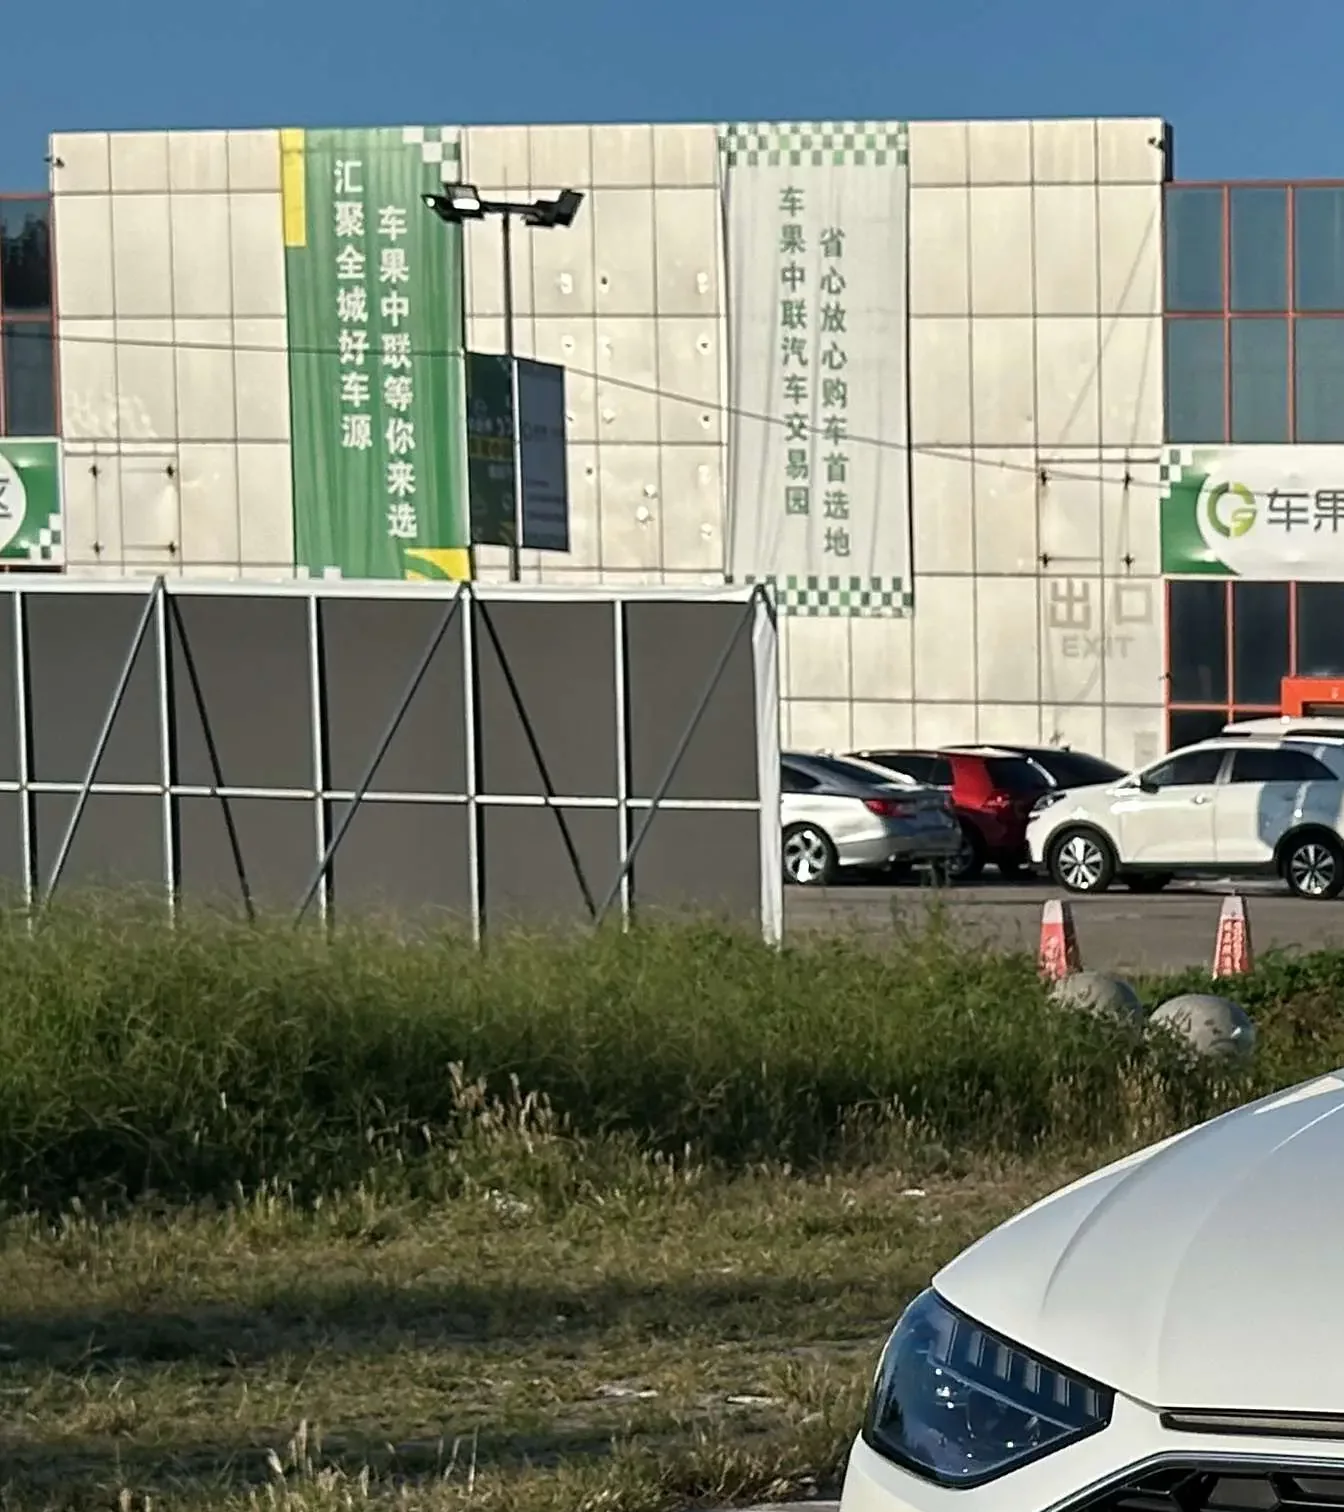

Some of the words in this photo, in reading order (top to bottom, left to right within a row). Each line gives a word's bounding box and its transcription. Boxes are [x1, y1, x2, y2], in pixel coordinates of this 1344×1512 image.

[334, 159, 373, 451] 汇聚全城好车源
[378, 205, 418, 539] 车果中联等你来选
[780, 186, 810, 516] 车果中联汽车交易园
[819, 228, 851, 557] 省心放心购车首选地
[1048, 578, 1153, 630] 出口
[1061, 634, 1136, 659] EXIT
